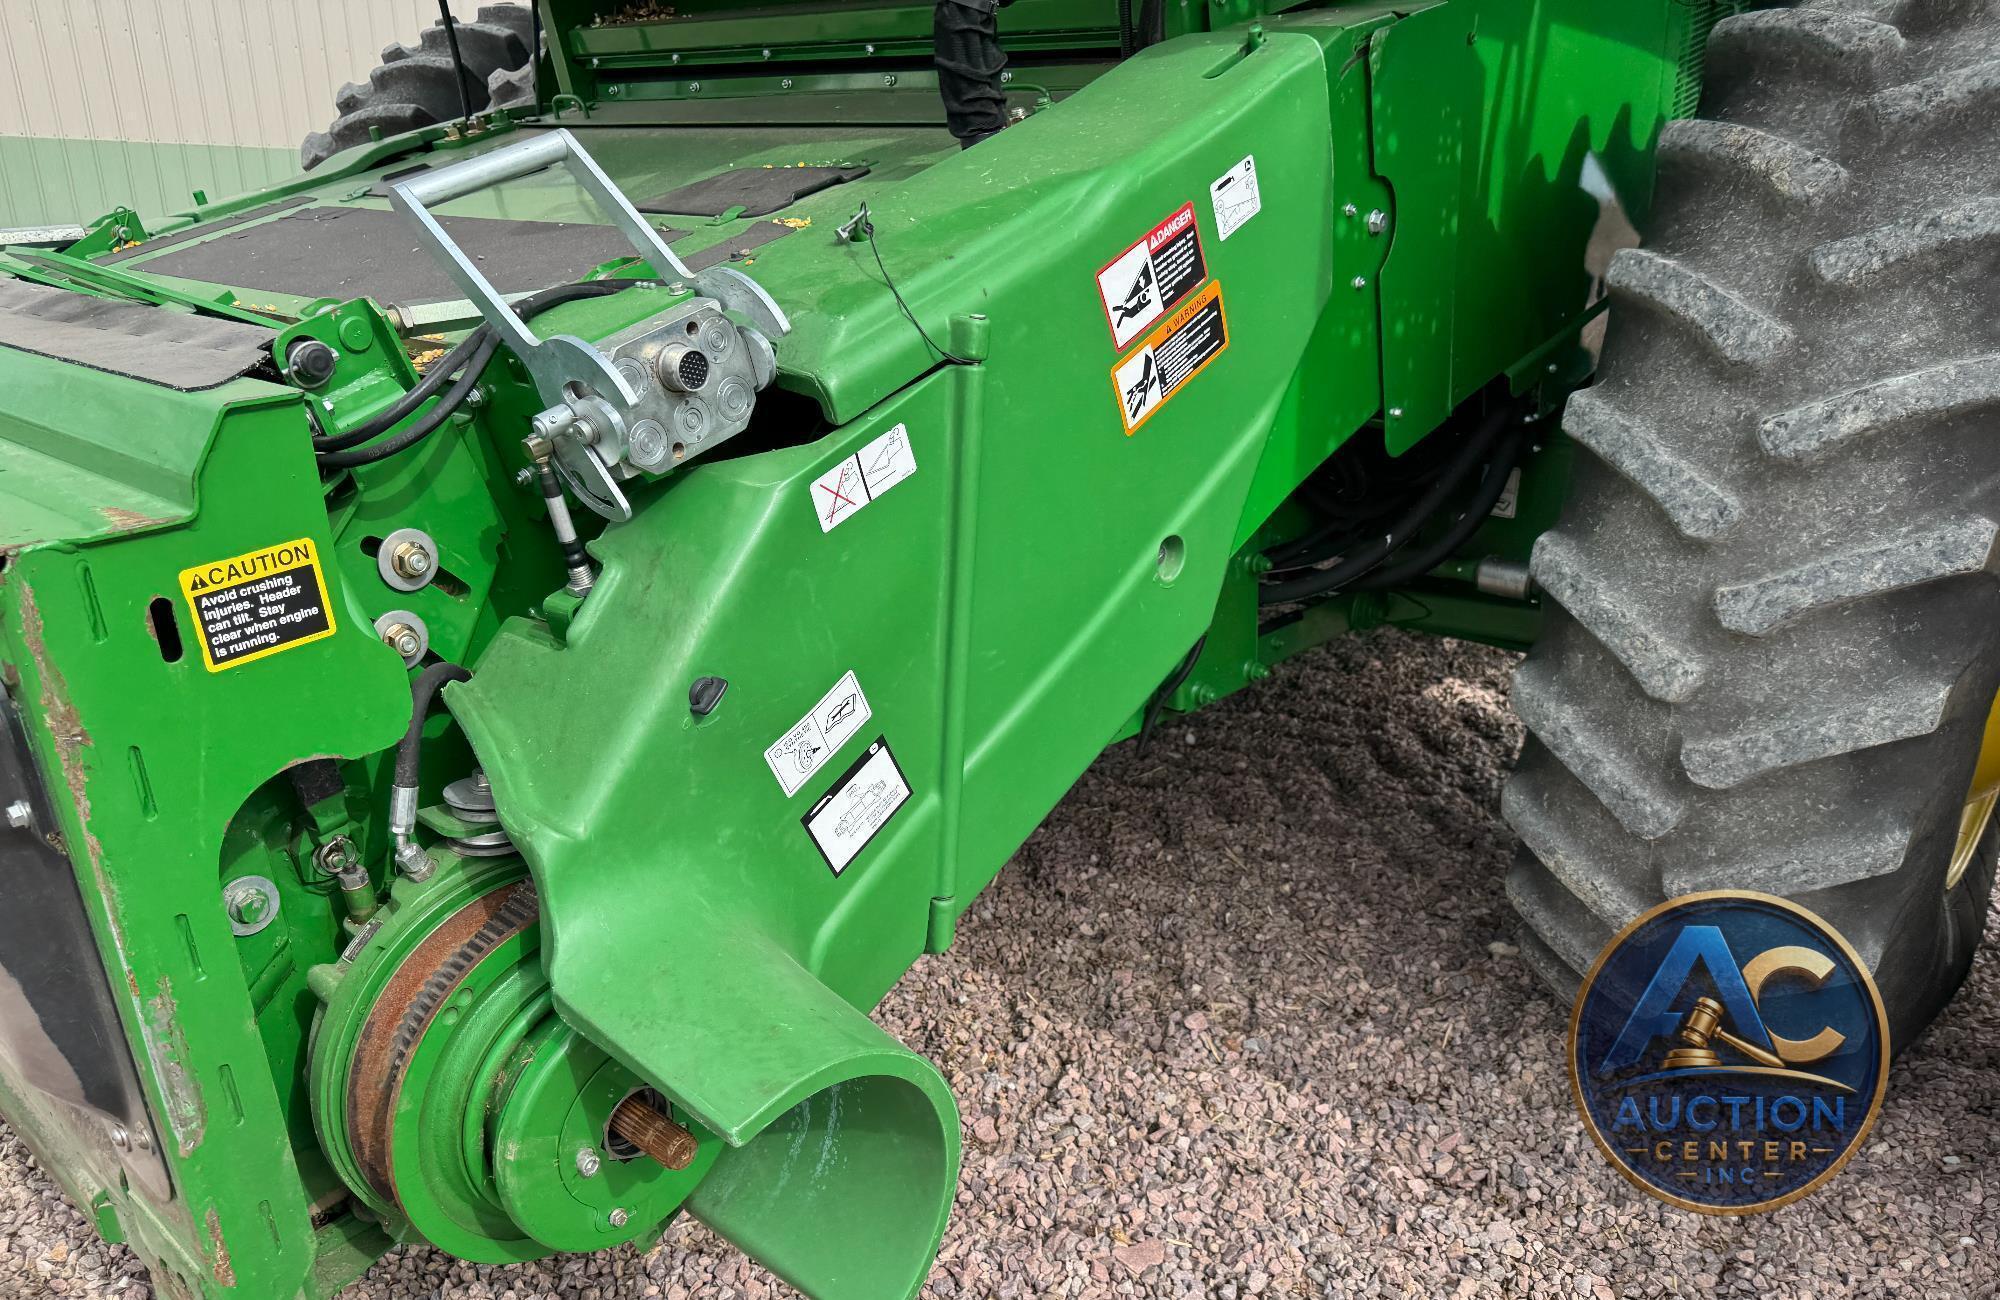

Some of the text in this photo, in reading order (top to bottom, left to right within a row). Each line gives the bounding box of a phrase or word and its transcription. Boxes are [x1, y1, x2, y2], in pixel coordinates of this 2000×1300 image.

[1157, 208, 1192, 242] DANGER
[1173, 294, 1207, 327] WARNING
[208, 543, 310, 585] CAUTION
[201, 575, 293, 609] Avoid crushing
[203, 585, 301, 621] injuries. Header
[208, 603, 286, 633] can tilt. Stay
[211, 606, 319, 646] clear when engine
[215, 631, 280, 658] is running.
